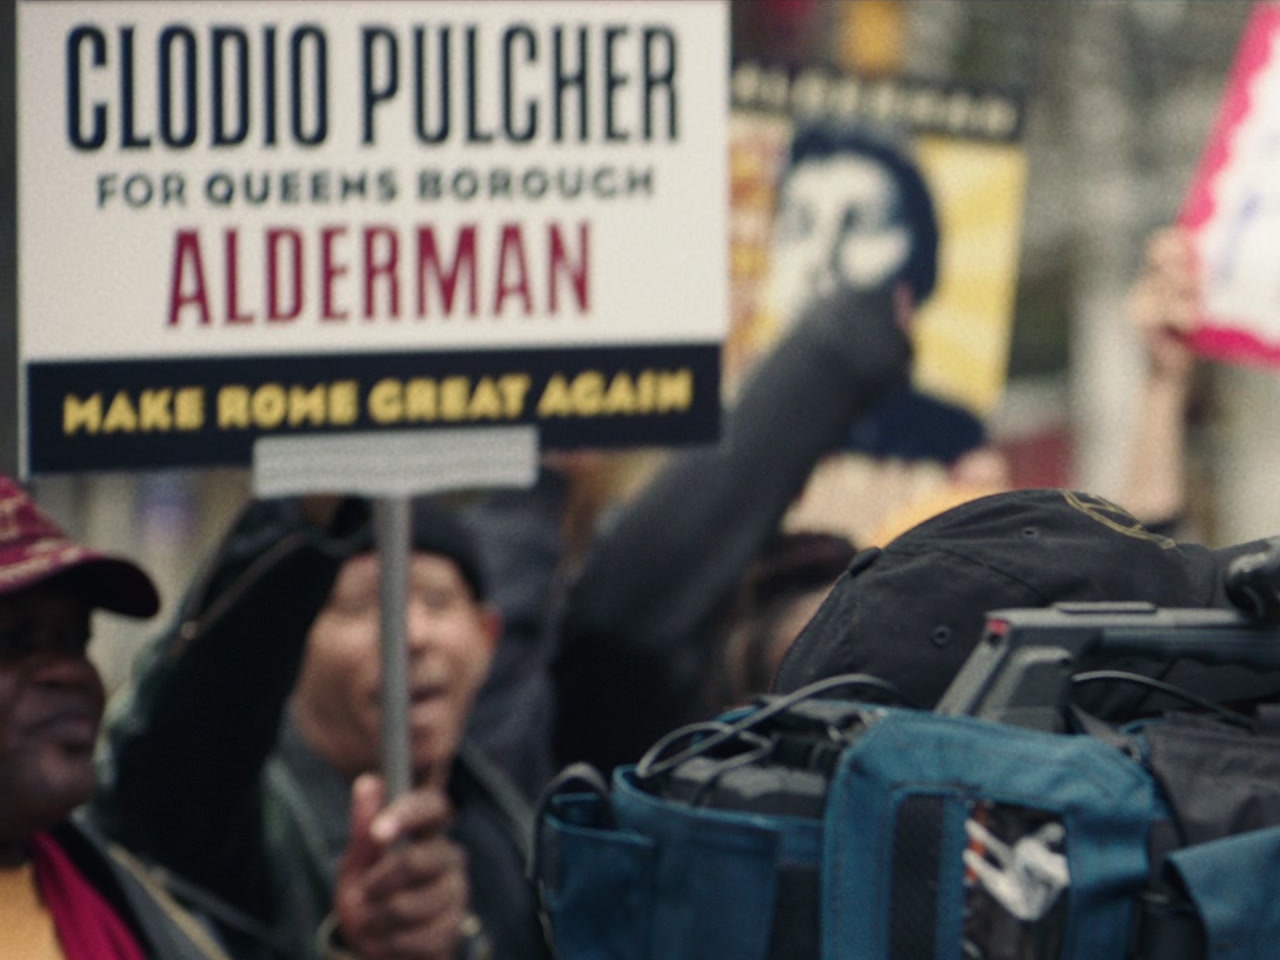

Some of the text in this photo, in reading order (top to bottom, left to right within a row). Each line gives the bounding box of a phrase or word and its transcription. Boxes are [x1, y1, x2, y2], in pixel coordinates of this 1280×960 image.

[64, 22, 680, 154] CLODIO PULCHER
[95, 165, 656, 210] FOR QUEENS BOROUGH
[165, 221, 592, 329] ALDERMAN
[63, 369, 693, 435] MAKE ROME GREAT AGAIN
